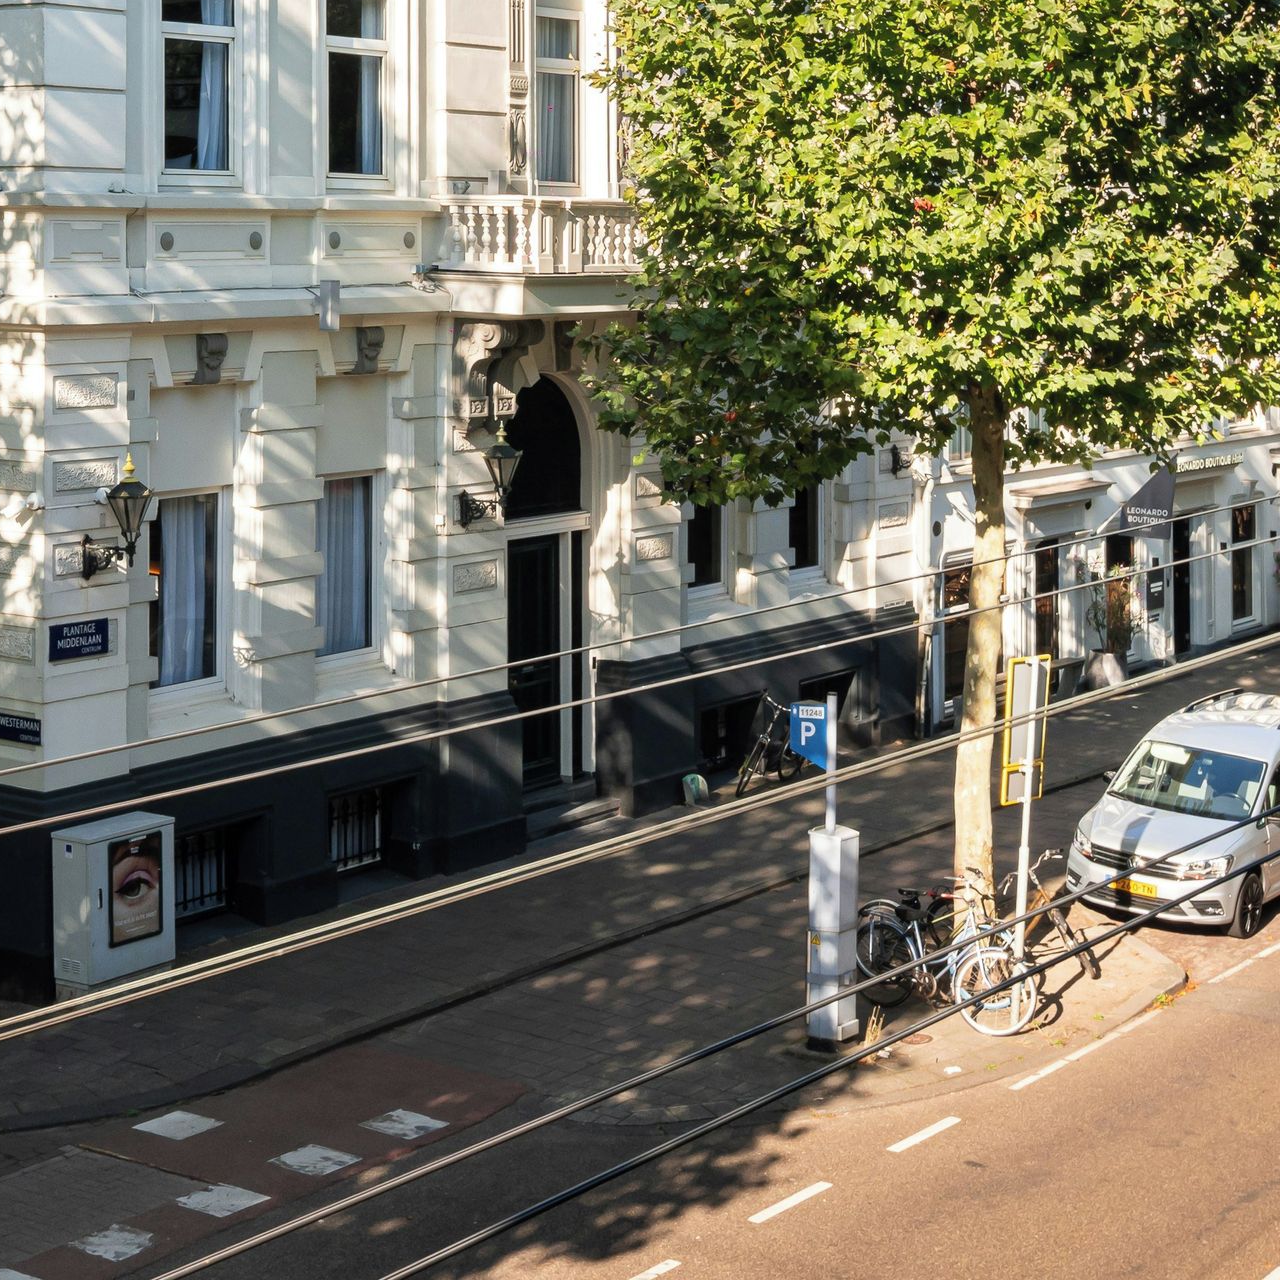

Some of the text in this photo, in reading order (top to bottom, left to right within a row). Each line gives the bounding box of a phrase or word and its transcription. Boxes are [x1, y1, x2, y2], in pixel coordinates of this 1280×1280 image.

[1205, 454, 1231, 468] BOUTIQUE
[1126, 506, 1169, 517] LEONARDO
[63, 623, 96, 637] PLANTAGE
[57, 633, 102, 649] MIDDENLAAN
[0, 715, 40, 732] WESTERMAN
[801, 721, 816, 746] P
